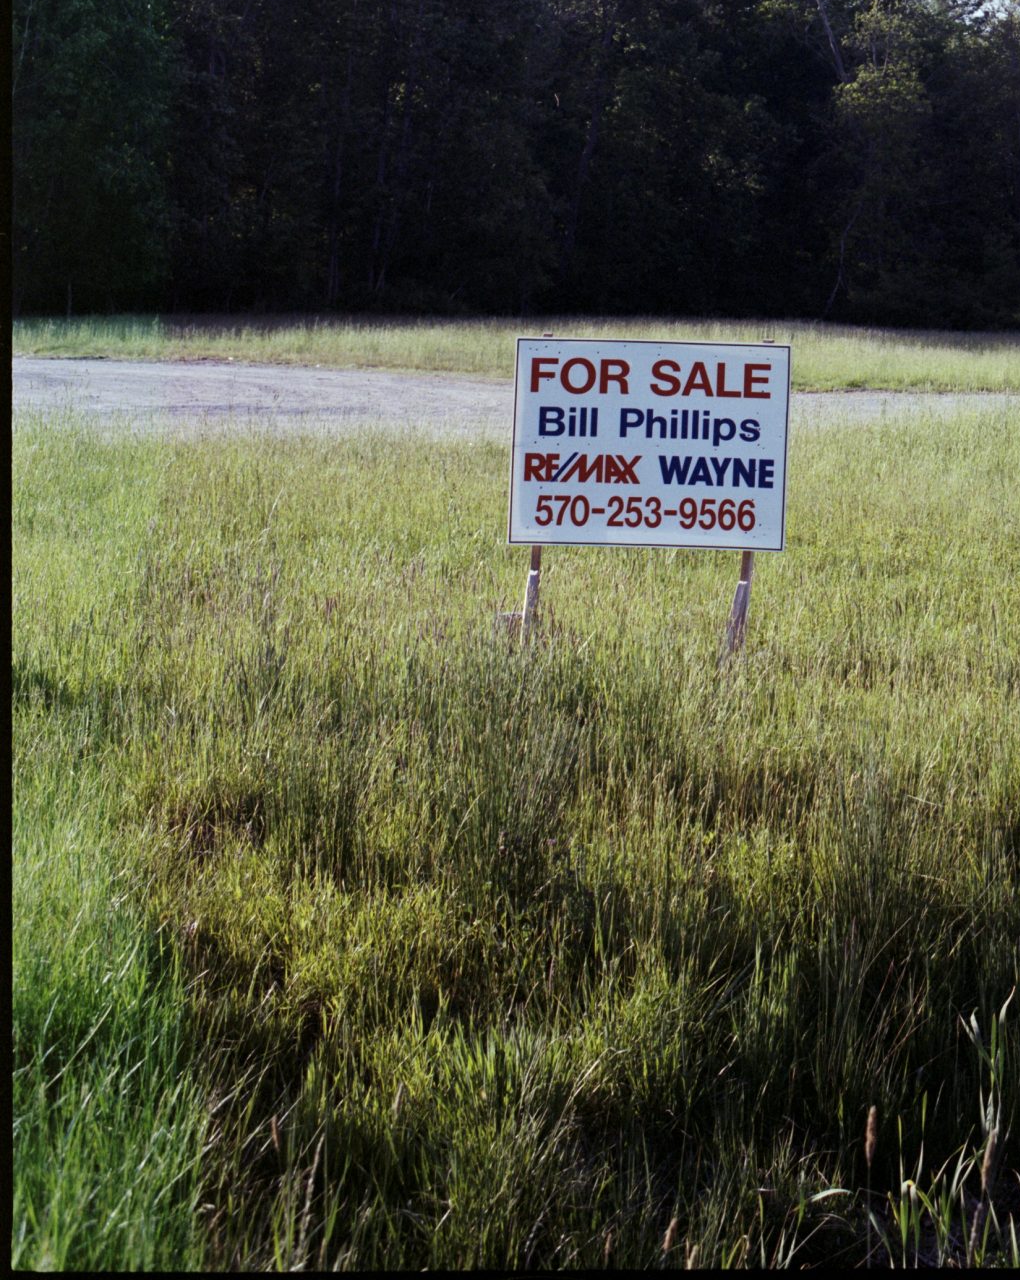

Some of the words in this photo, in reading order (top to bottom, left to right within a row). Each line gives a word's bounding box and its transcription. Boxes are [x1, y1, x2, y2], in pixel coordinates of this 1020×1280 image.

[530, 357, 630, 394] FOR
[649, 359, 772, 399] SALE
[538, 406, 598, 437] Bill
[619, 407, 761, 446] Phillips
[523, 452, 642, 484] RE/MAX
[658, 455, 775, 489] WAYNE
[534, 494, 756, 531] 570-253-9566
